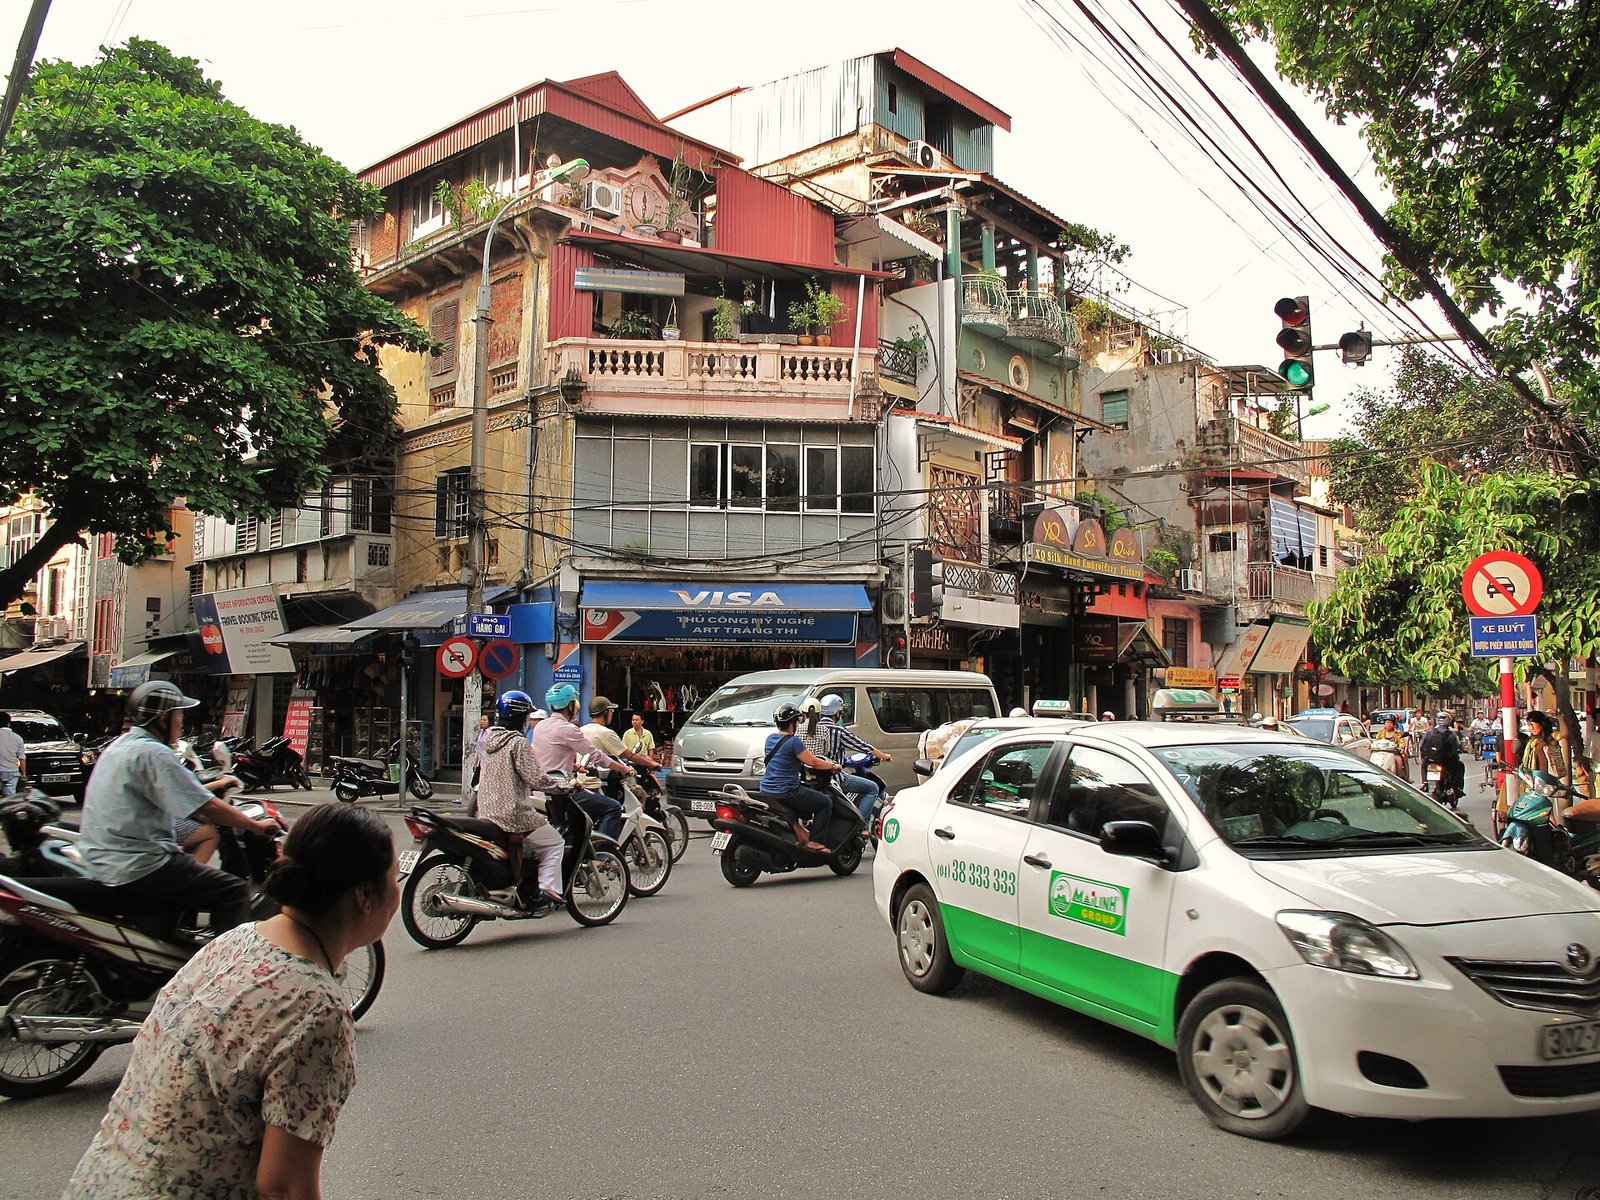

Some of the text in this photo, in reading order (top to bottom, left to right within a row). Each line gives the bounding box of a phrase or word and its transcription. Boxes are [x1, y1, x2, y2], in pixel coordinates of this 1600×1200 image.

[1042, 520, 1065, 545] XQ
[1035, 548, 1046, 562] XQ
[1047, 550, 1062, 563] Silk
[1064, 554, 1081, 567] Hand
[1082, 559, 1117, 574] Embroidery
[668, 589, 785, 606] VISA
[260, 610, 279, 621] OFFICE
[708, 615, 748, 624] CÔNG
[777, 617, 815, 626] NGHỆ
[495, 624, 505, 633] GAI
[692, 626, 720, 634] ART
[1482, 622, 1525, 633] XE BUÝT
[937, 859, 1016, 896] (04) 38 333 333
[1081, 909, 1116, 925] GROUP
